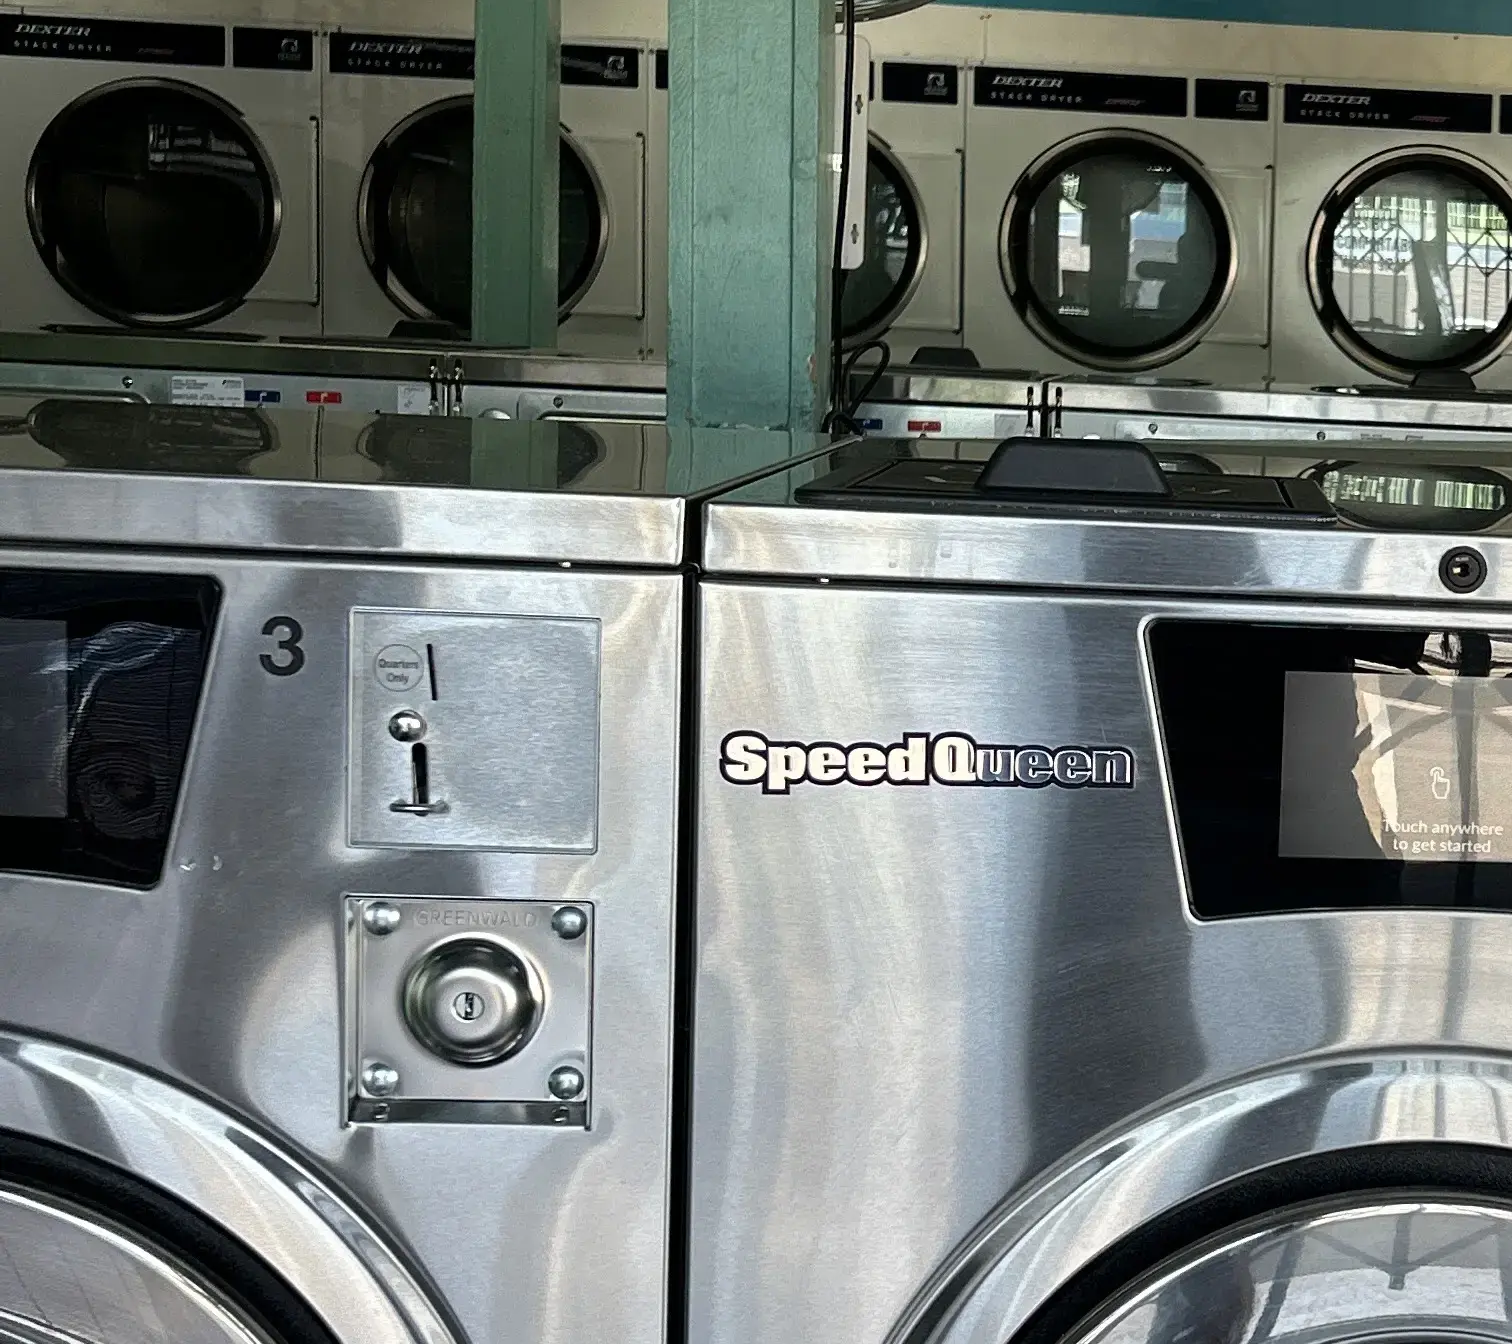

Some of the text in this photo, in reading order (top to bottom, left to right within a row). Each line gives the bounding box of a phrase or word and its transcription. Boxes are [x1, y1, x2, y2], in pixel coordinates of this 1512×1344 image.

[15, 24, 91, 36] DEXTER
[992, 76, 1064, 87] DEXTER
[1301, 93, 1371, 105] DEXTER
[259, 615, 305, 676] 3
[378, 658, 419, 669] Quarters
[386, 672, 410, 685] Only
[1383, 819, 1504, 836] Touch anywhere
[1393, 840, 1491, 853] to get started
[413, 909, 538, 928] GREENWALD
